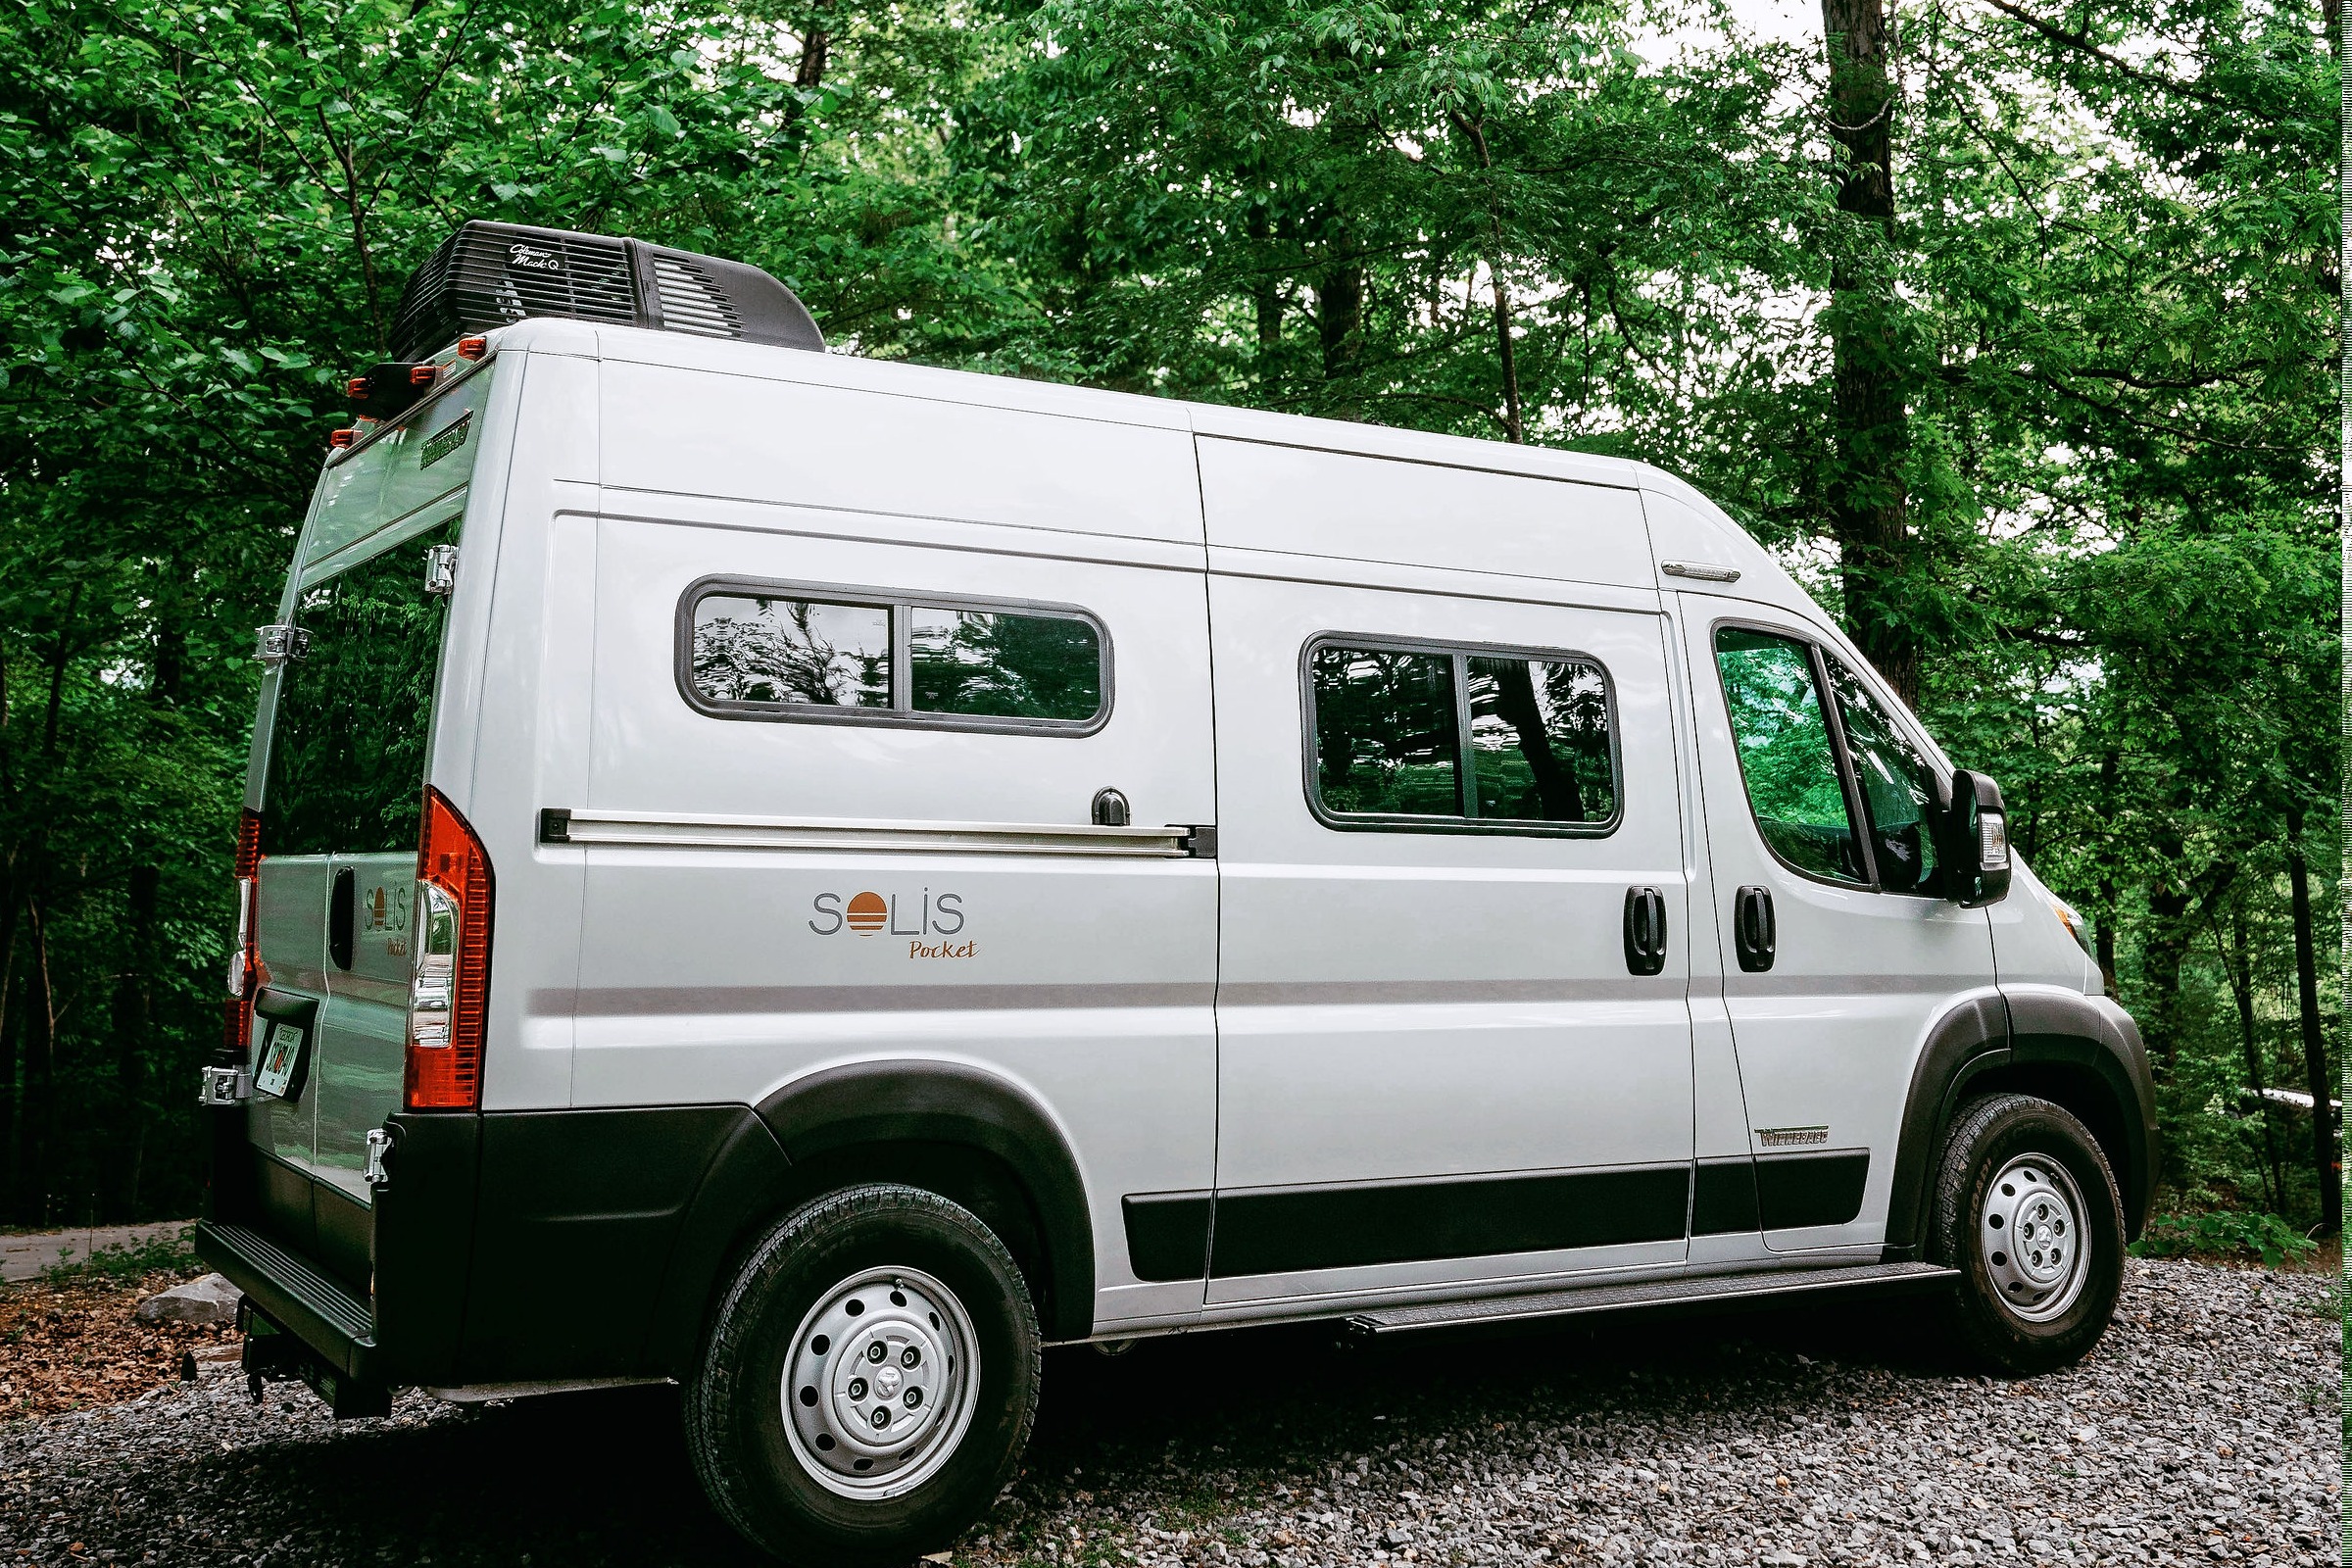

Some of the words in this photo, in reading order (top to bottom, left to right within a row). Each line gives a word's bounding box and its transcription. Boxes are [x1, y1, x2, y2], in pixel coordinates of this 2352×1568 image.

[510, 244, 552, 258] Coleman
[512, 254, 548, 269] Mach
[548, 259, 560, 270] Q
[909, 939, 981, 959] Pocket
